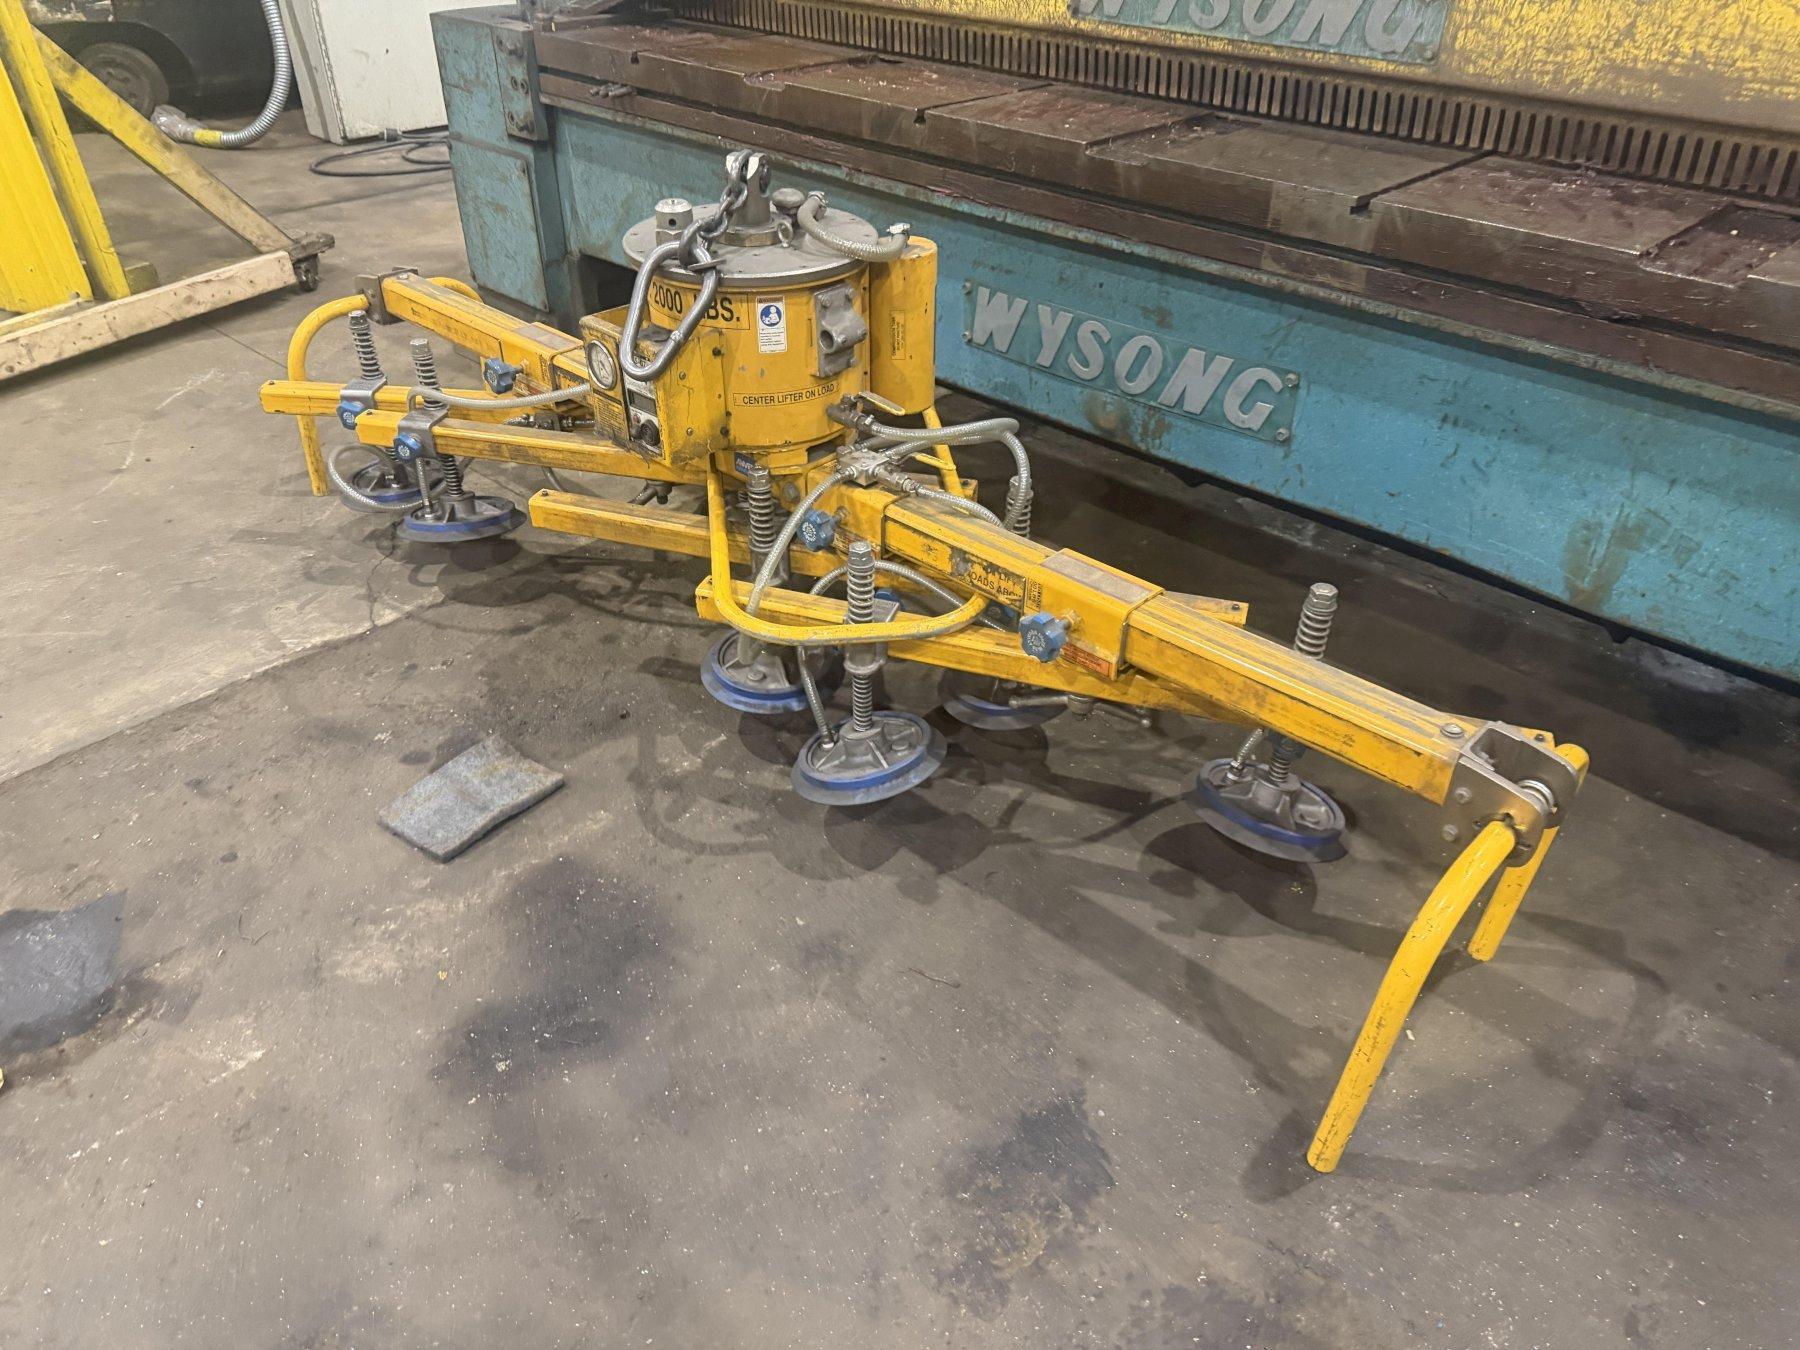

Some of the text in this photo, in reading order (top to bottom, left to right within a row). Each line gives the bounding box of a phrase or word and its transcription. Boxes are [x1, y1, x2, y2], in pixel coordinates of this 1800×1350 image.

[652, 281, 740, 322] 2000 BS.
[972, 286, 1283, 432] WYSONG
[742, 383, 835, 405] CENTER LIFTER ON LOAD
